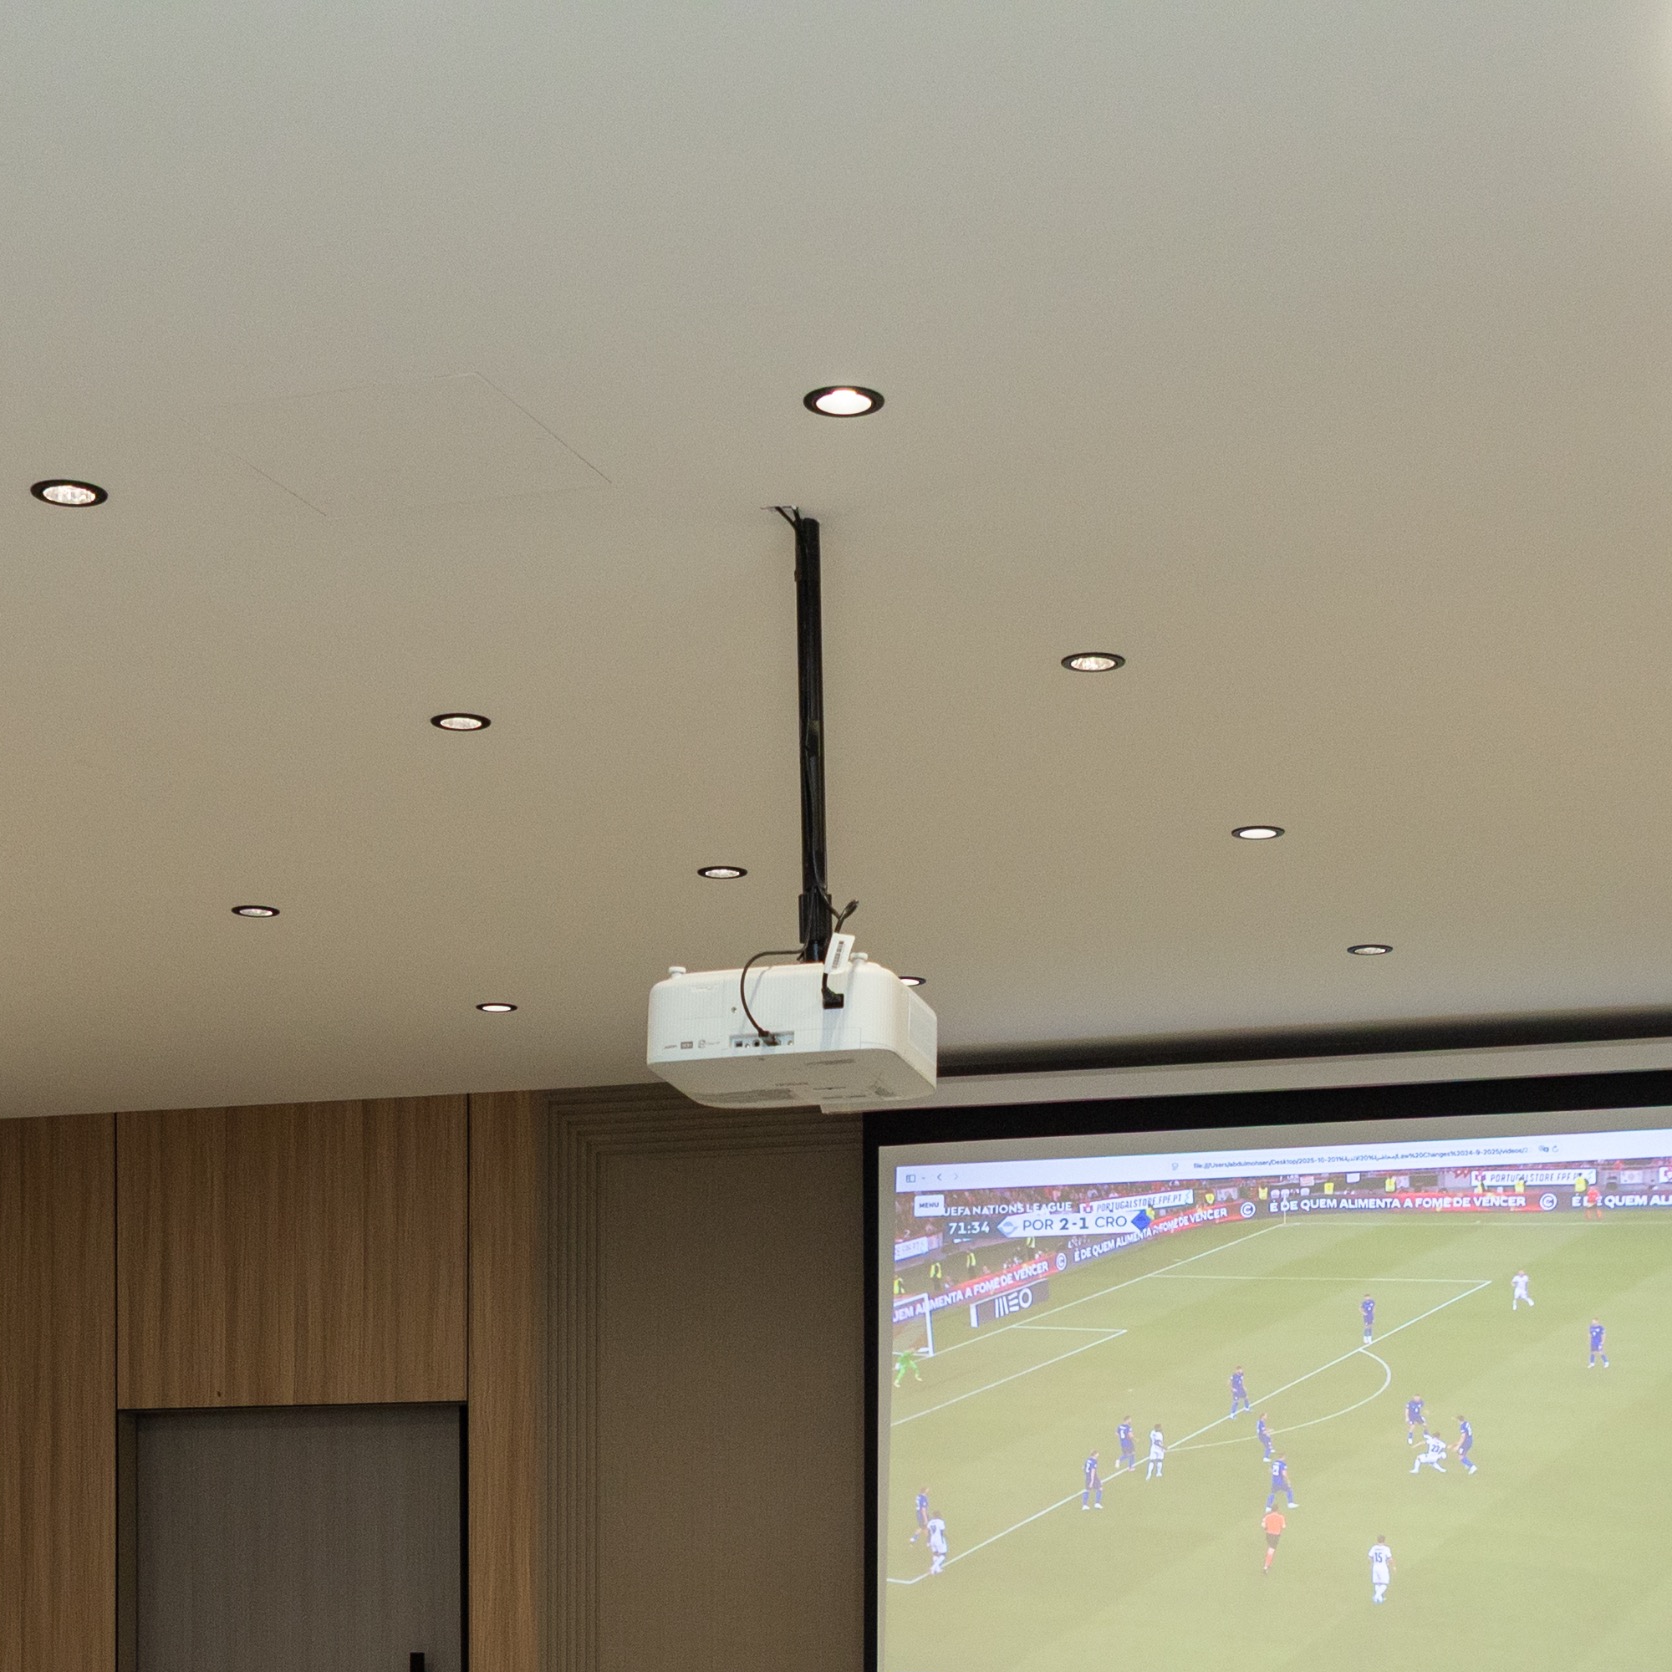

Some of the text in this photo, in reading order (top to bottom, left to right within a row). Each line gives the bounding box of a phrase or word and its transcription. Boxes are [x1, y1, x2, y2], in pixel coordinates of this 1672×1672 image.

[1281, 1200, 1298, 1212] DE
[1300, 1199, 1337, 1211] QUEM
[1339, 1198, 1400, 1209] ALIMENTA
[1403, 1198, 1413, 1208] A
[1415, 1197, 1451, 1208] FOME
[1453, 1197, 1470, 1208] DE
[1473, 1196, 1526, 1207] VENCER
[1604, 1194, 1648, 1208] QUEM
[944, 1202, 1072, 1216] UEFA NATIONS LEAGUE
[948, 1221, 990, 1234] 71:34
[1022, 1219, 1054, 1231] POR
[1094, 1216, 1128, 1229] CRO
[1081, 1247, 1092, 1259] DE
[1092, 1239, 1115, 1257] QUEM
[1116, 1228, 1152, 1248] ALIMENTA
[1179, 1214, 1189, 1226] DE
[1190, 1207, 1228, 1222] VENCER
[965, 1287, 973, 1298] A
[974, 1279, 1000, 1296] FOME
[1001, 1274, 1013, 1287] DE
[1014, 1261, 1049, 1283] VENCER
